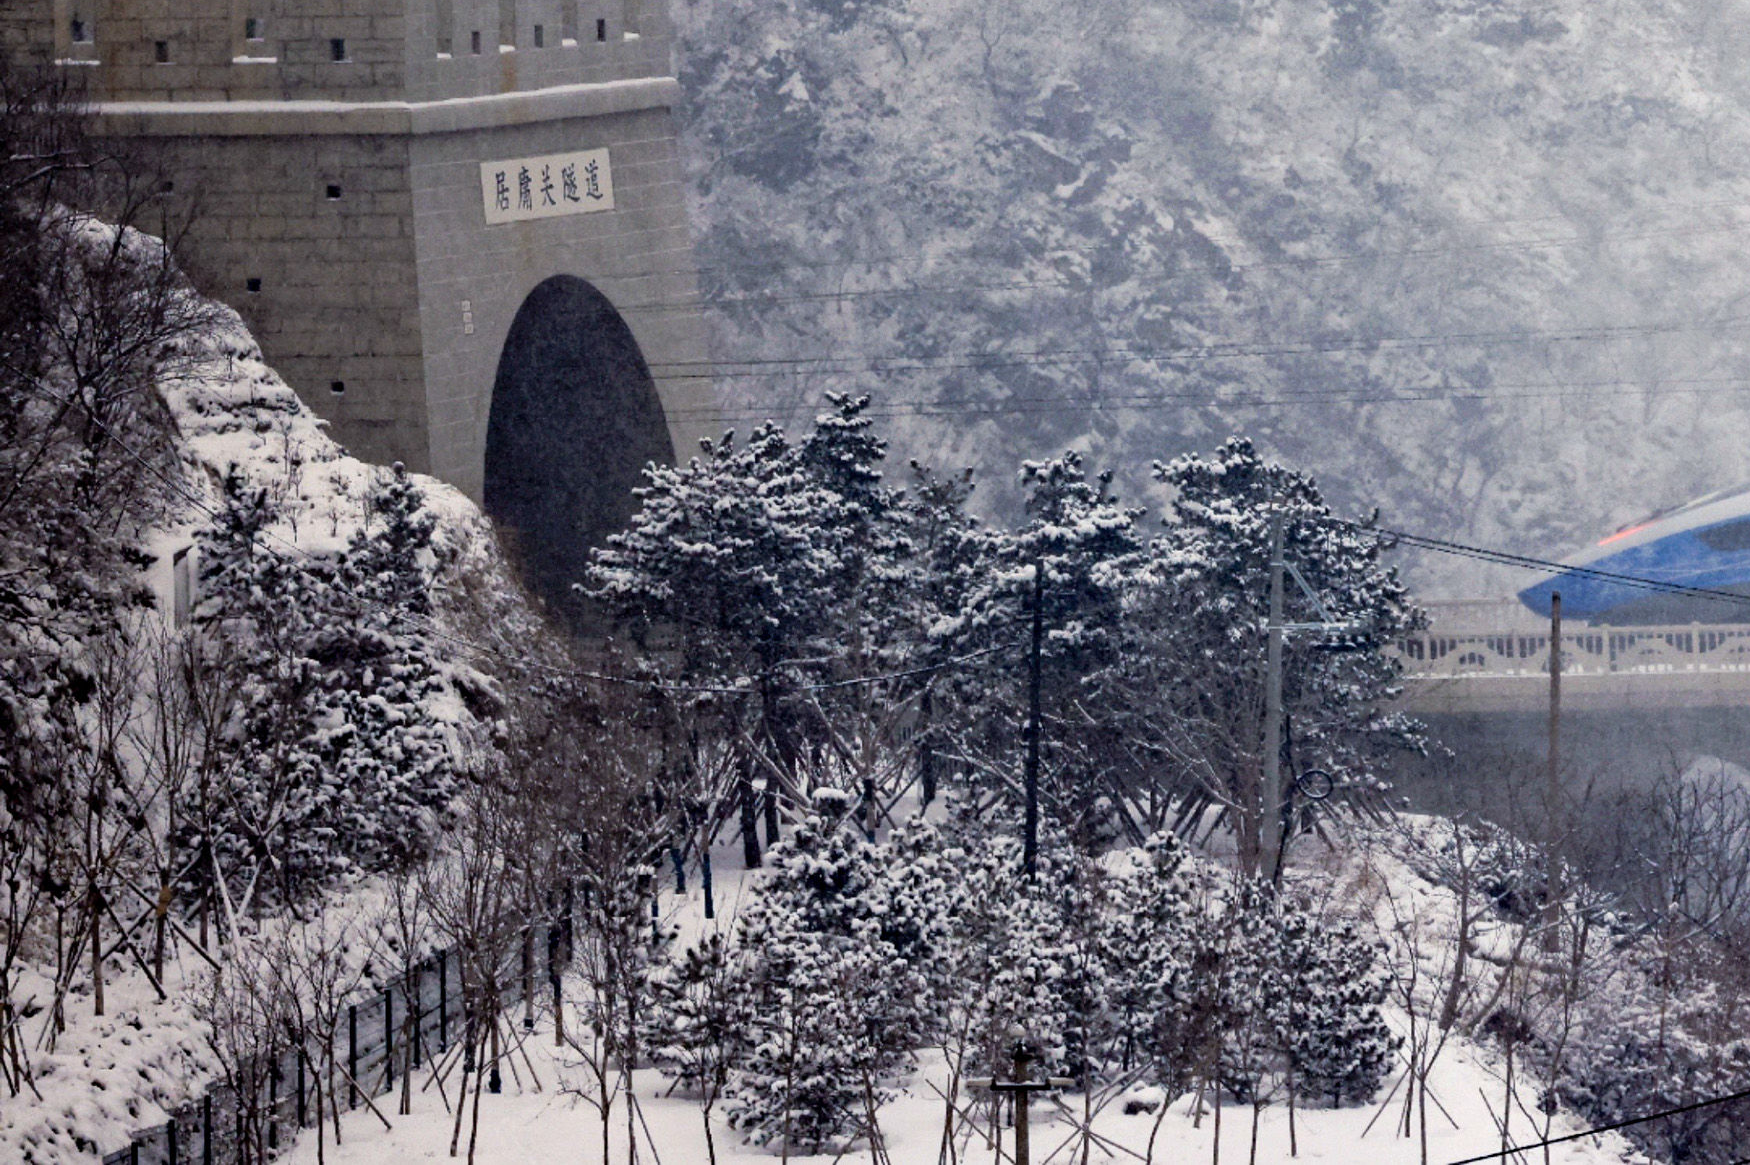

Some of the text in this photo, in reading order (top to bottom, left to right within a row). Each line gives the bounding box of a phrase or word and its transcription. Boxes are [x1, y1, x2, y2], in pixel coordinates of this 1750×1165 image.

[495, 158, 604, 211] 居庸关隧道
